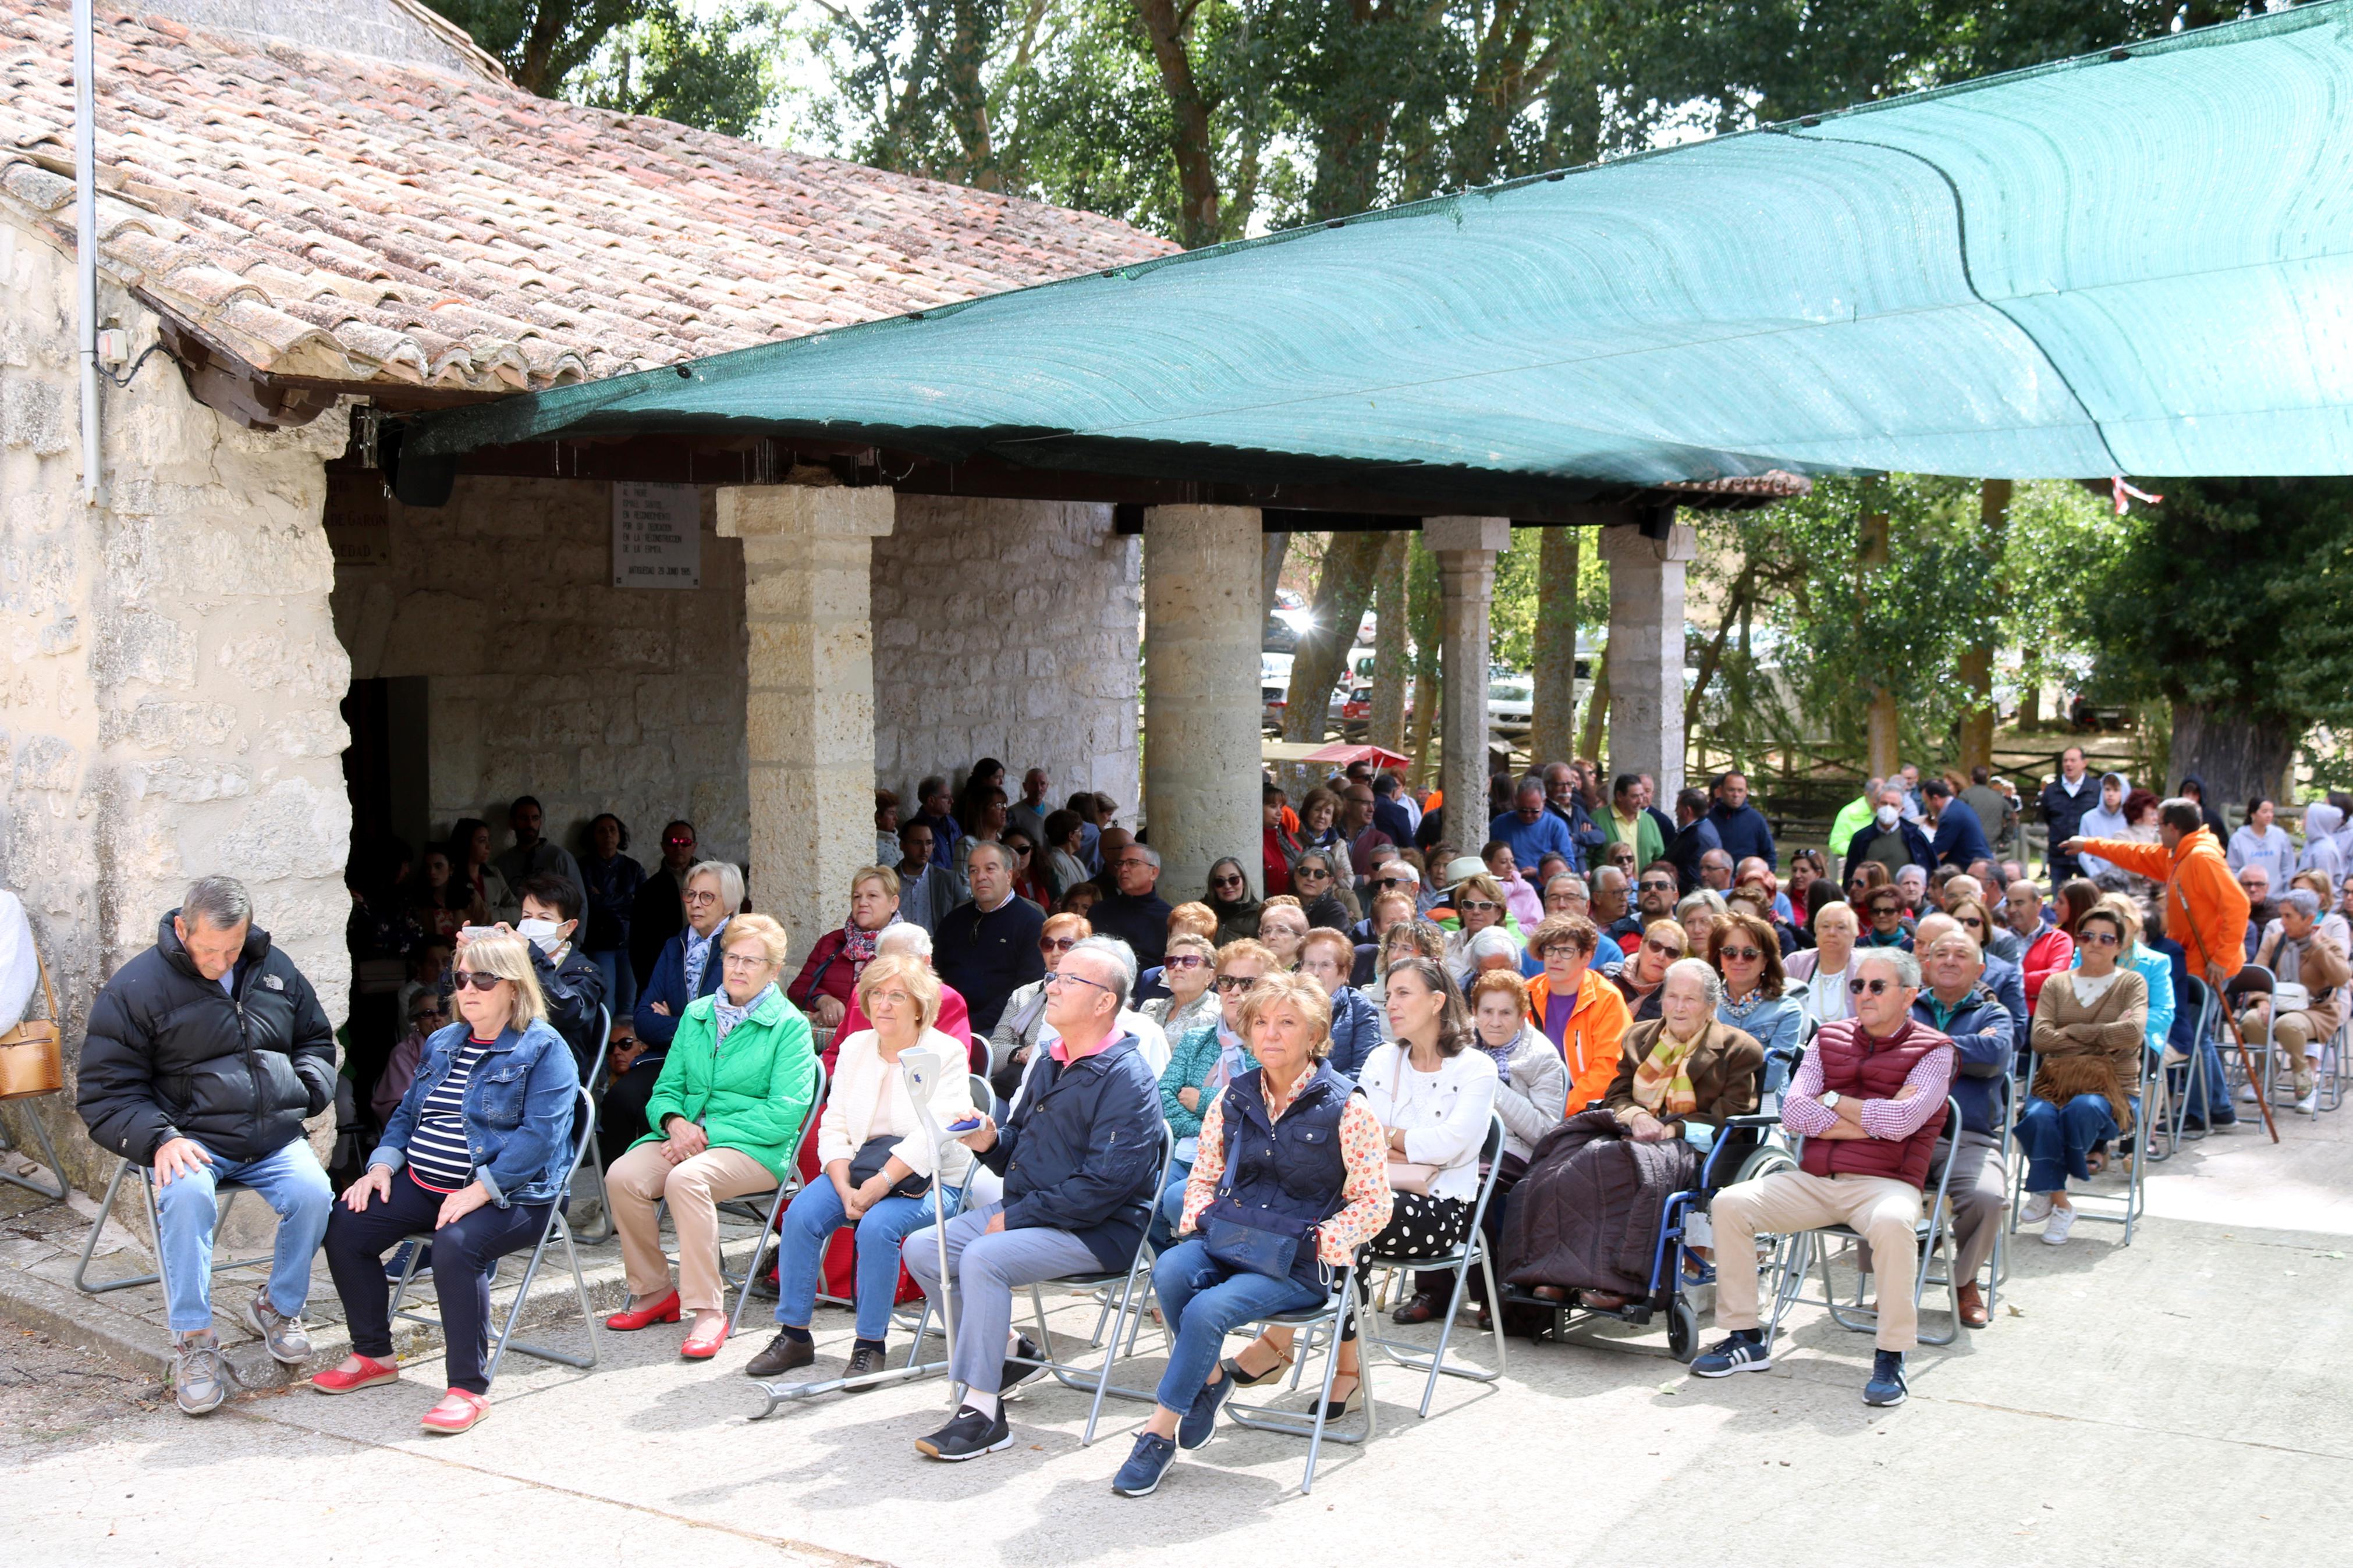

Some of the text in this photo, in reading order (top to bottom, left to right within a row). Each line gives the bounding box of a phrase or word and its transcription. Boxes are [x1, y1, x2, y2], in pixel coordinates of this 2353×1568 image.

[623, 521, 632, 530] POR
[623, 532, 629, 541] EN
[634, 533, 640, 542] LA
[623, 544, 629, 553] DE
[634, 545, 640, 553] LA
